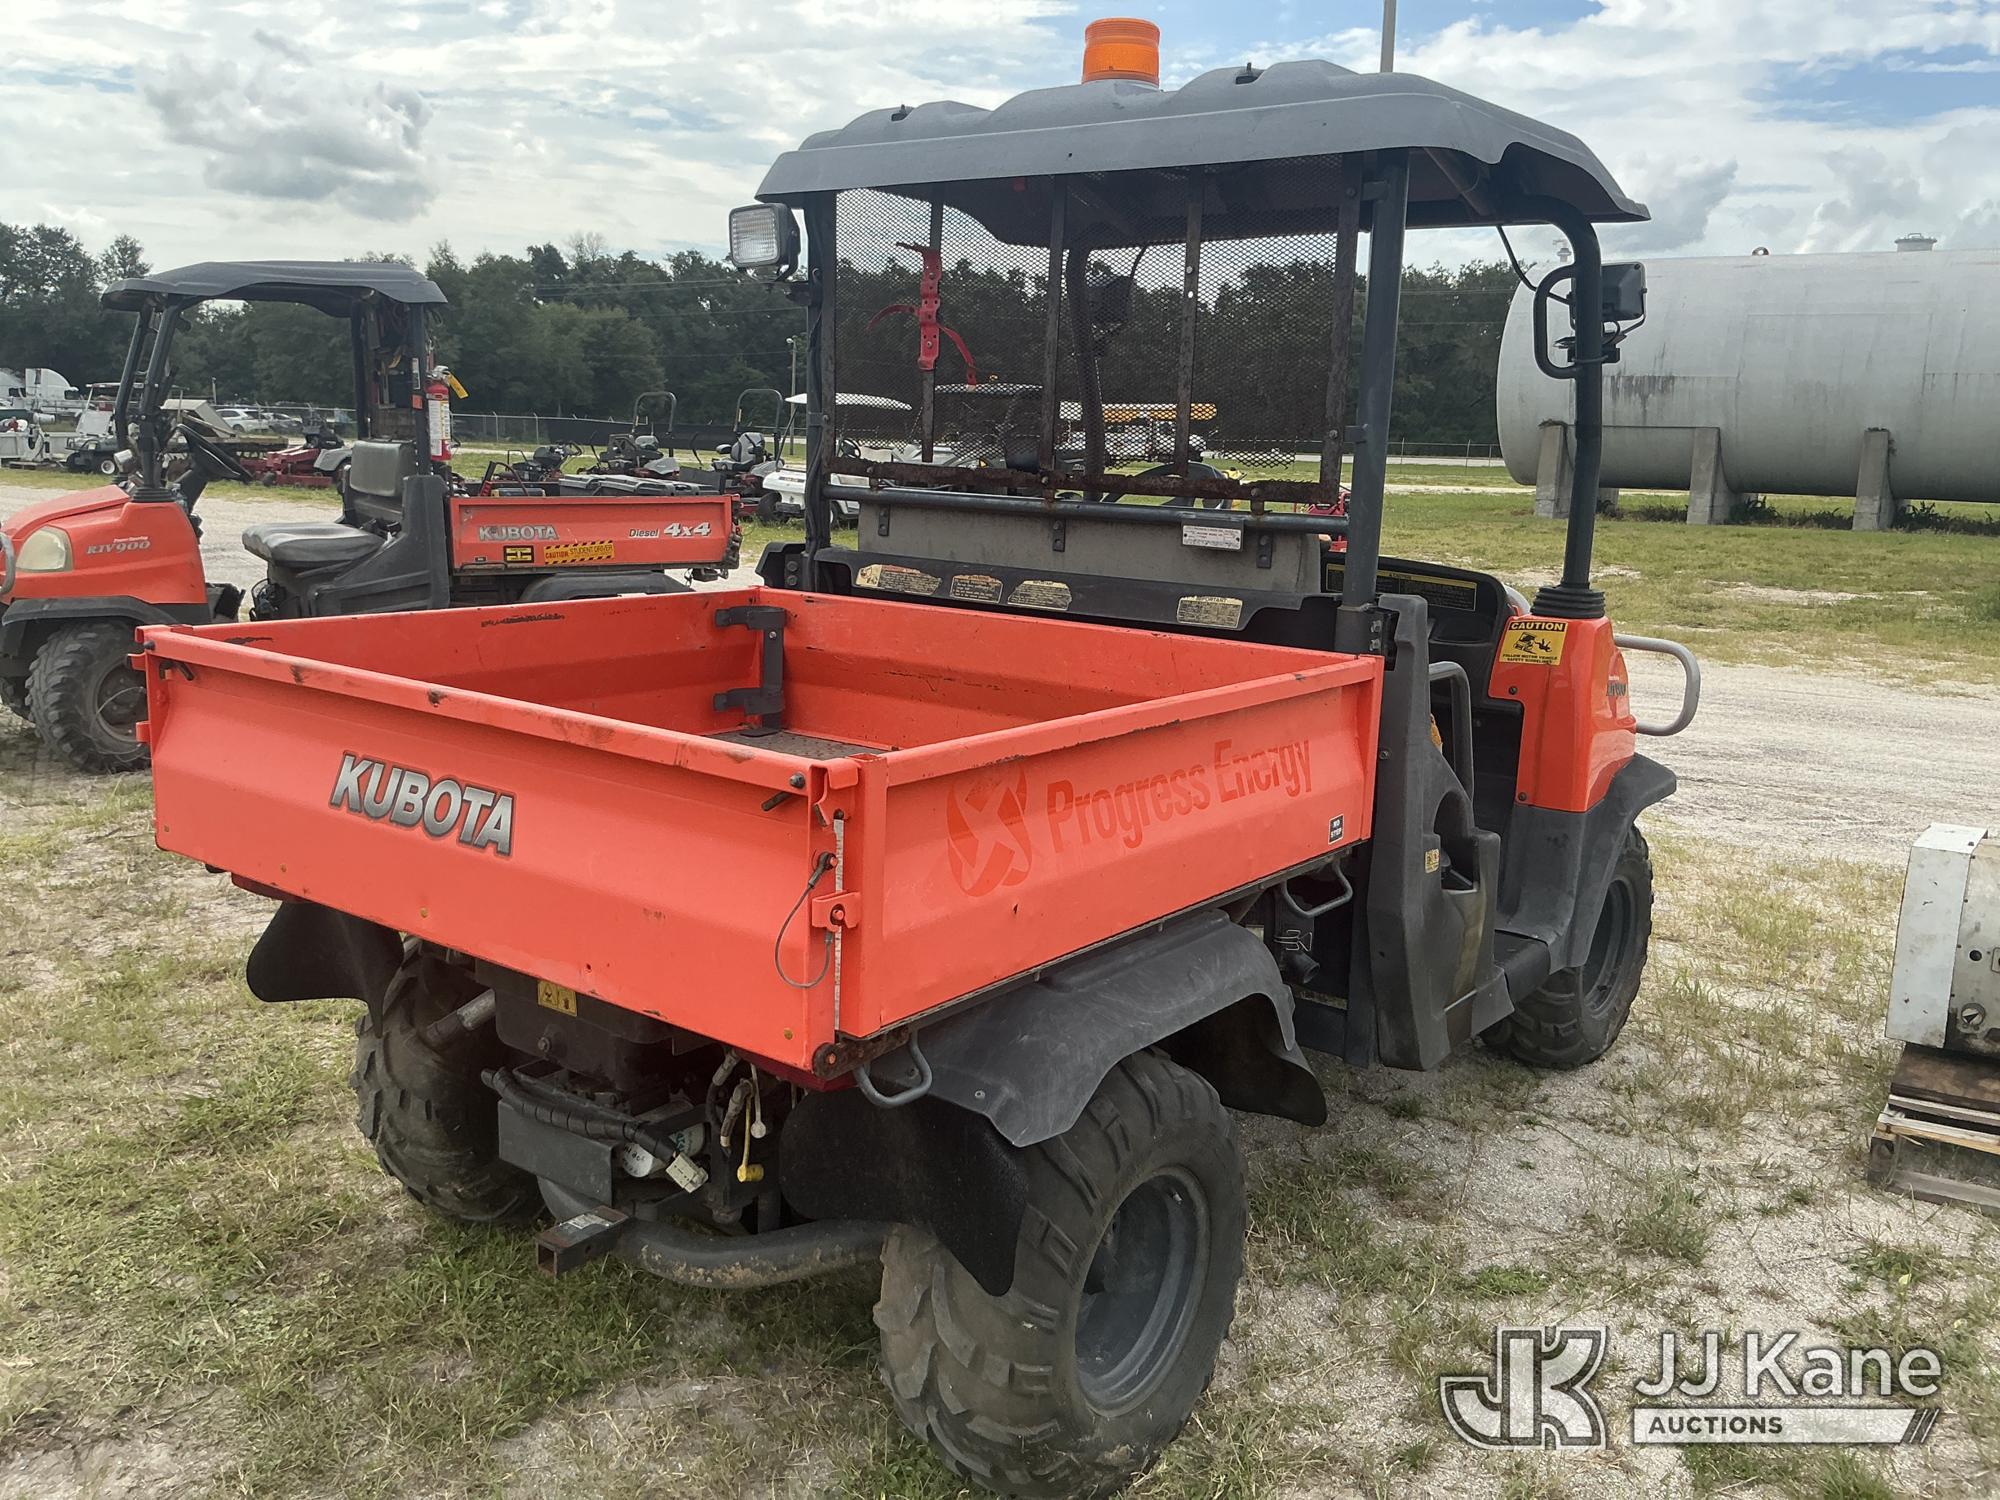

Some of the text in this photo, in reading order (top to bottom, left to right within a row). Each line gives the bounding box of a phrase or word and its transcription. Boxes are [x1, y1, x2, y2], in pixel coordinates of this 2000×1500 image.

[479, 524, 559, 541] KUBOTA
[628, 521, 712, 538] Diesel 4x4
[1511, 622, 1563, 630] CAUTION
[330, 753, 514, 855] KUBOTA
[1047, 739, 1312, 853] Progress Energy
